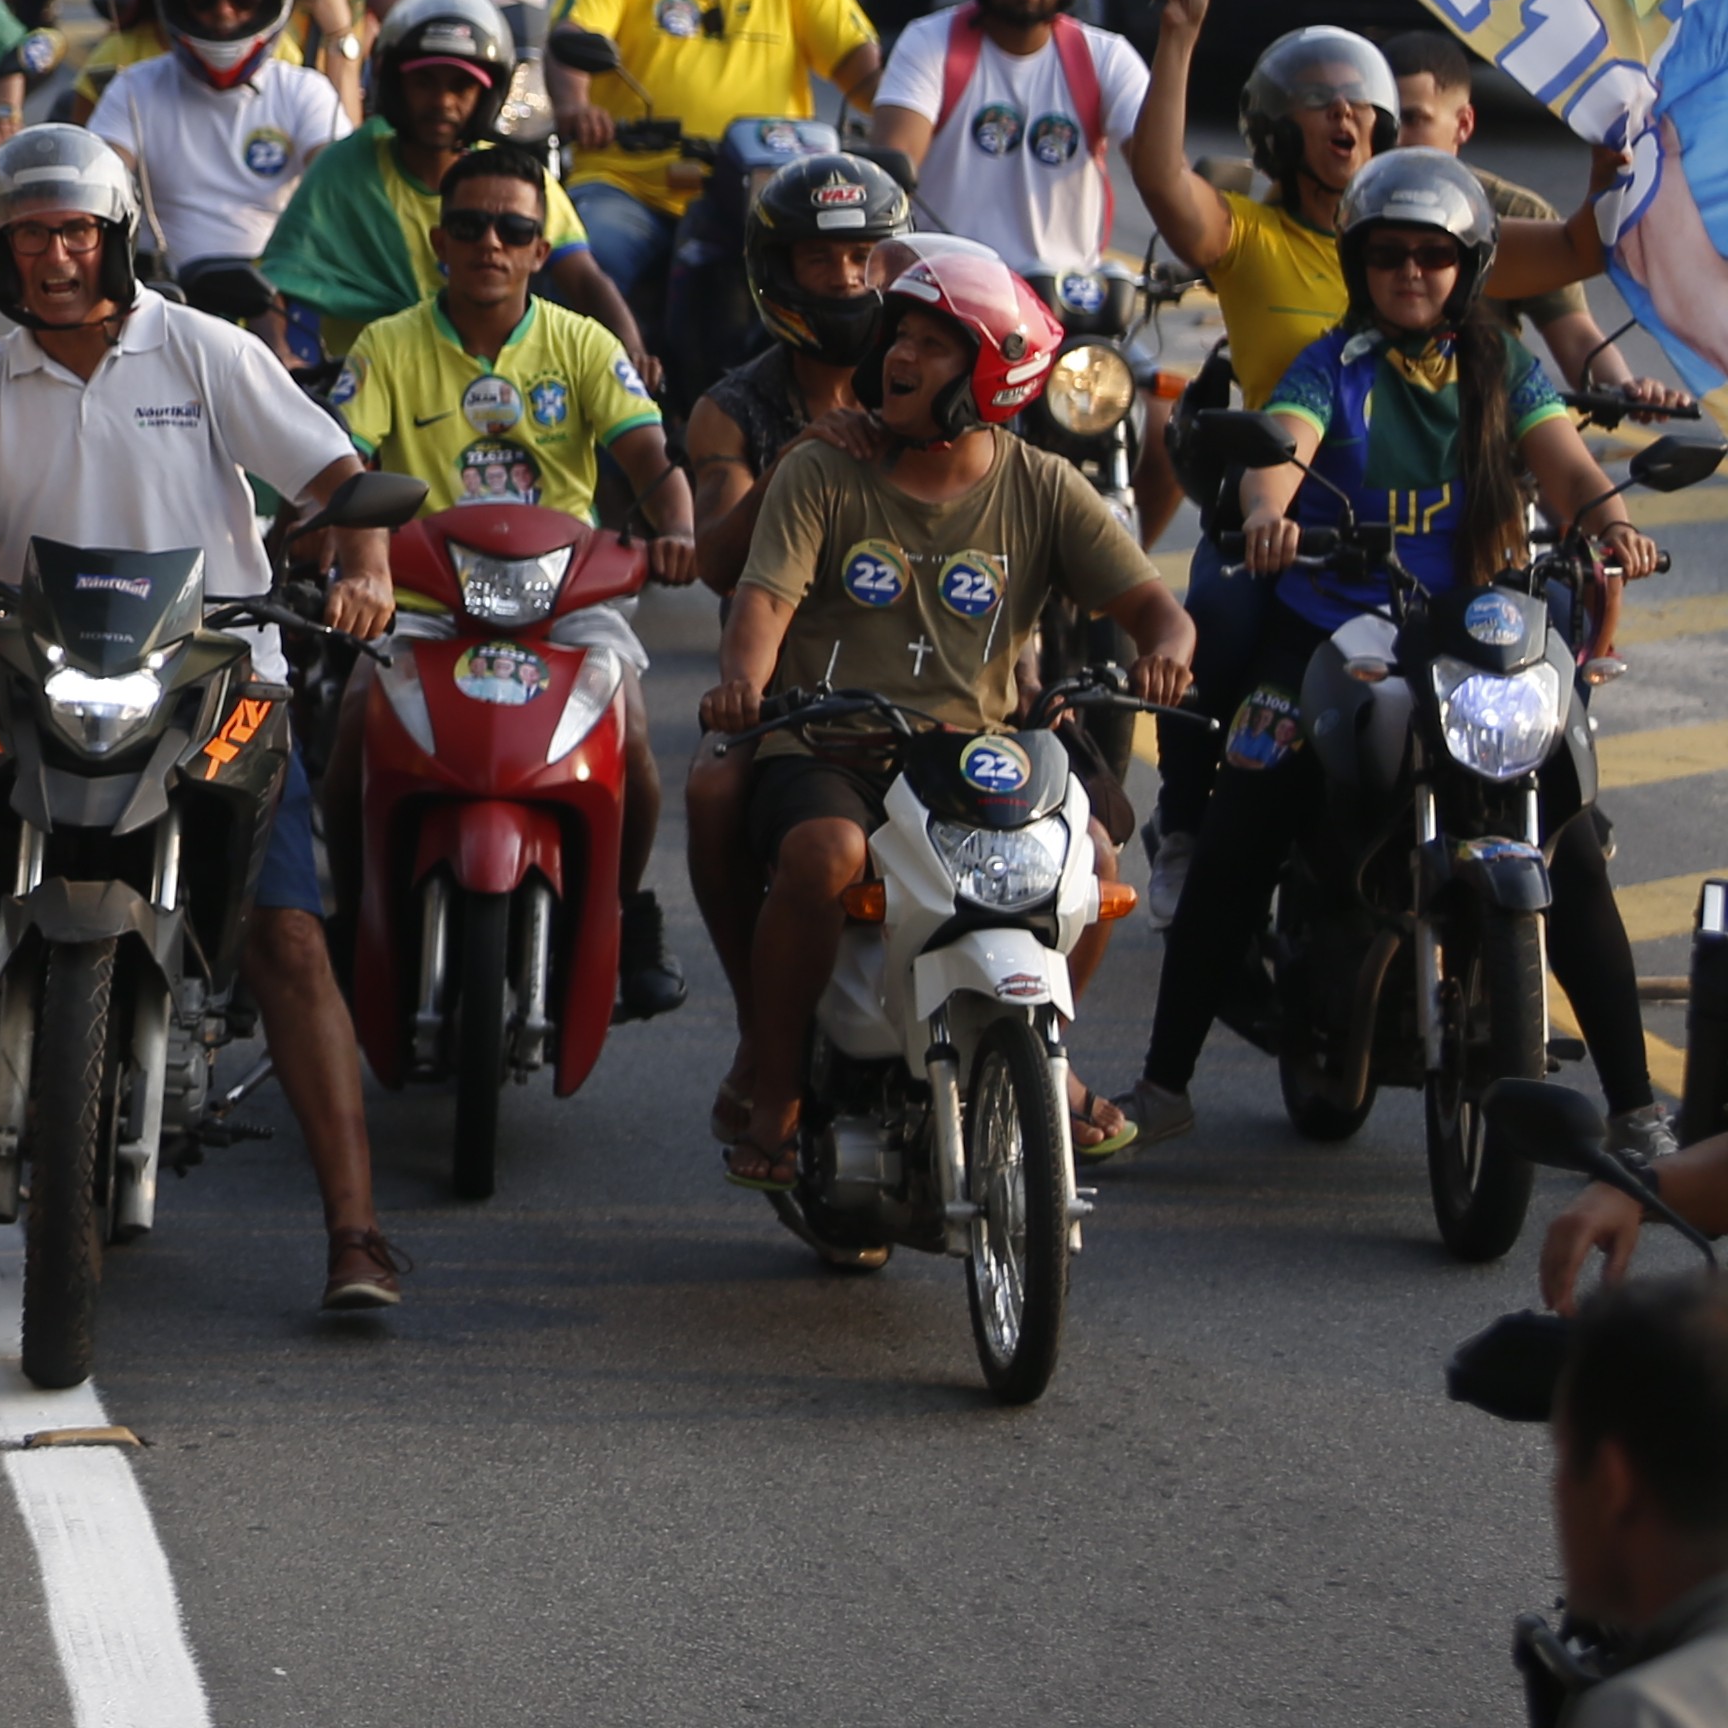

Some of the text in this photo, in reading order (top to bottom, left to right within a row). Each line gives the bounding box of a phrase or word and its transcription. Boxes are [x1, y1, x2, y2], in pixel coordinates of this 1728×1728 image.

[853, 561, 896, 592] 22
[950, 572, 992, 603] 22
[80, 631, 136, 644] HONDA
[974, 753, 1018, 780] 22
